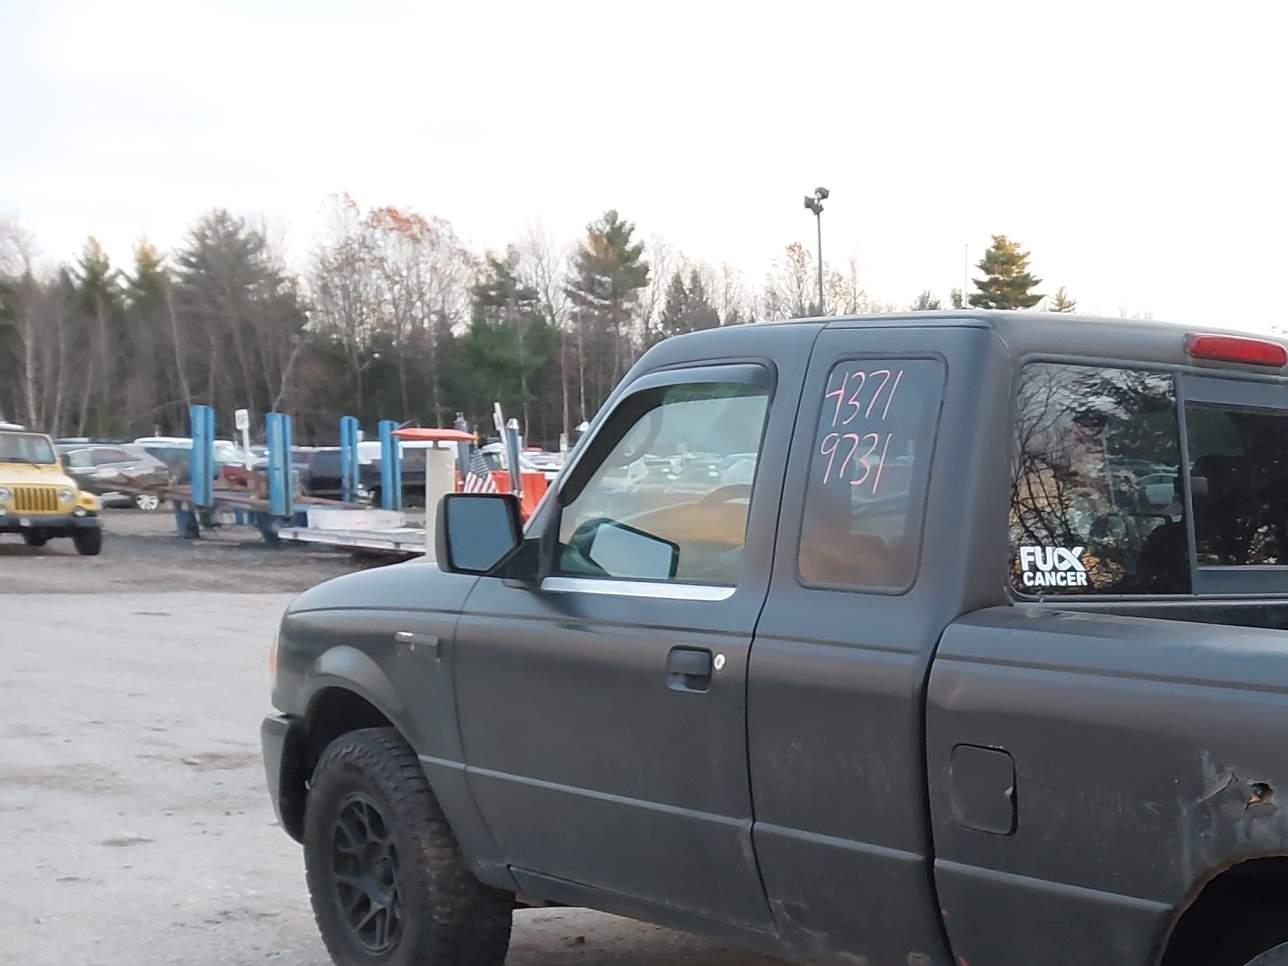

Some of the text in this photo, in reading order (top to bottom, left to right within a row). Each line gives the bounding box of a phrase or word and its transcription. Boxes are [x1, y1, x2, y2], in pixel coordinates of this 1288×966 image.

[825, 369, 903, 427] 4371
[820, 432, 892, 495] 9731
[1023, 571, 1089, 586] CANCER
